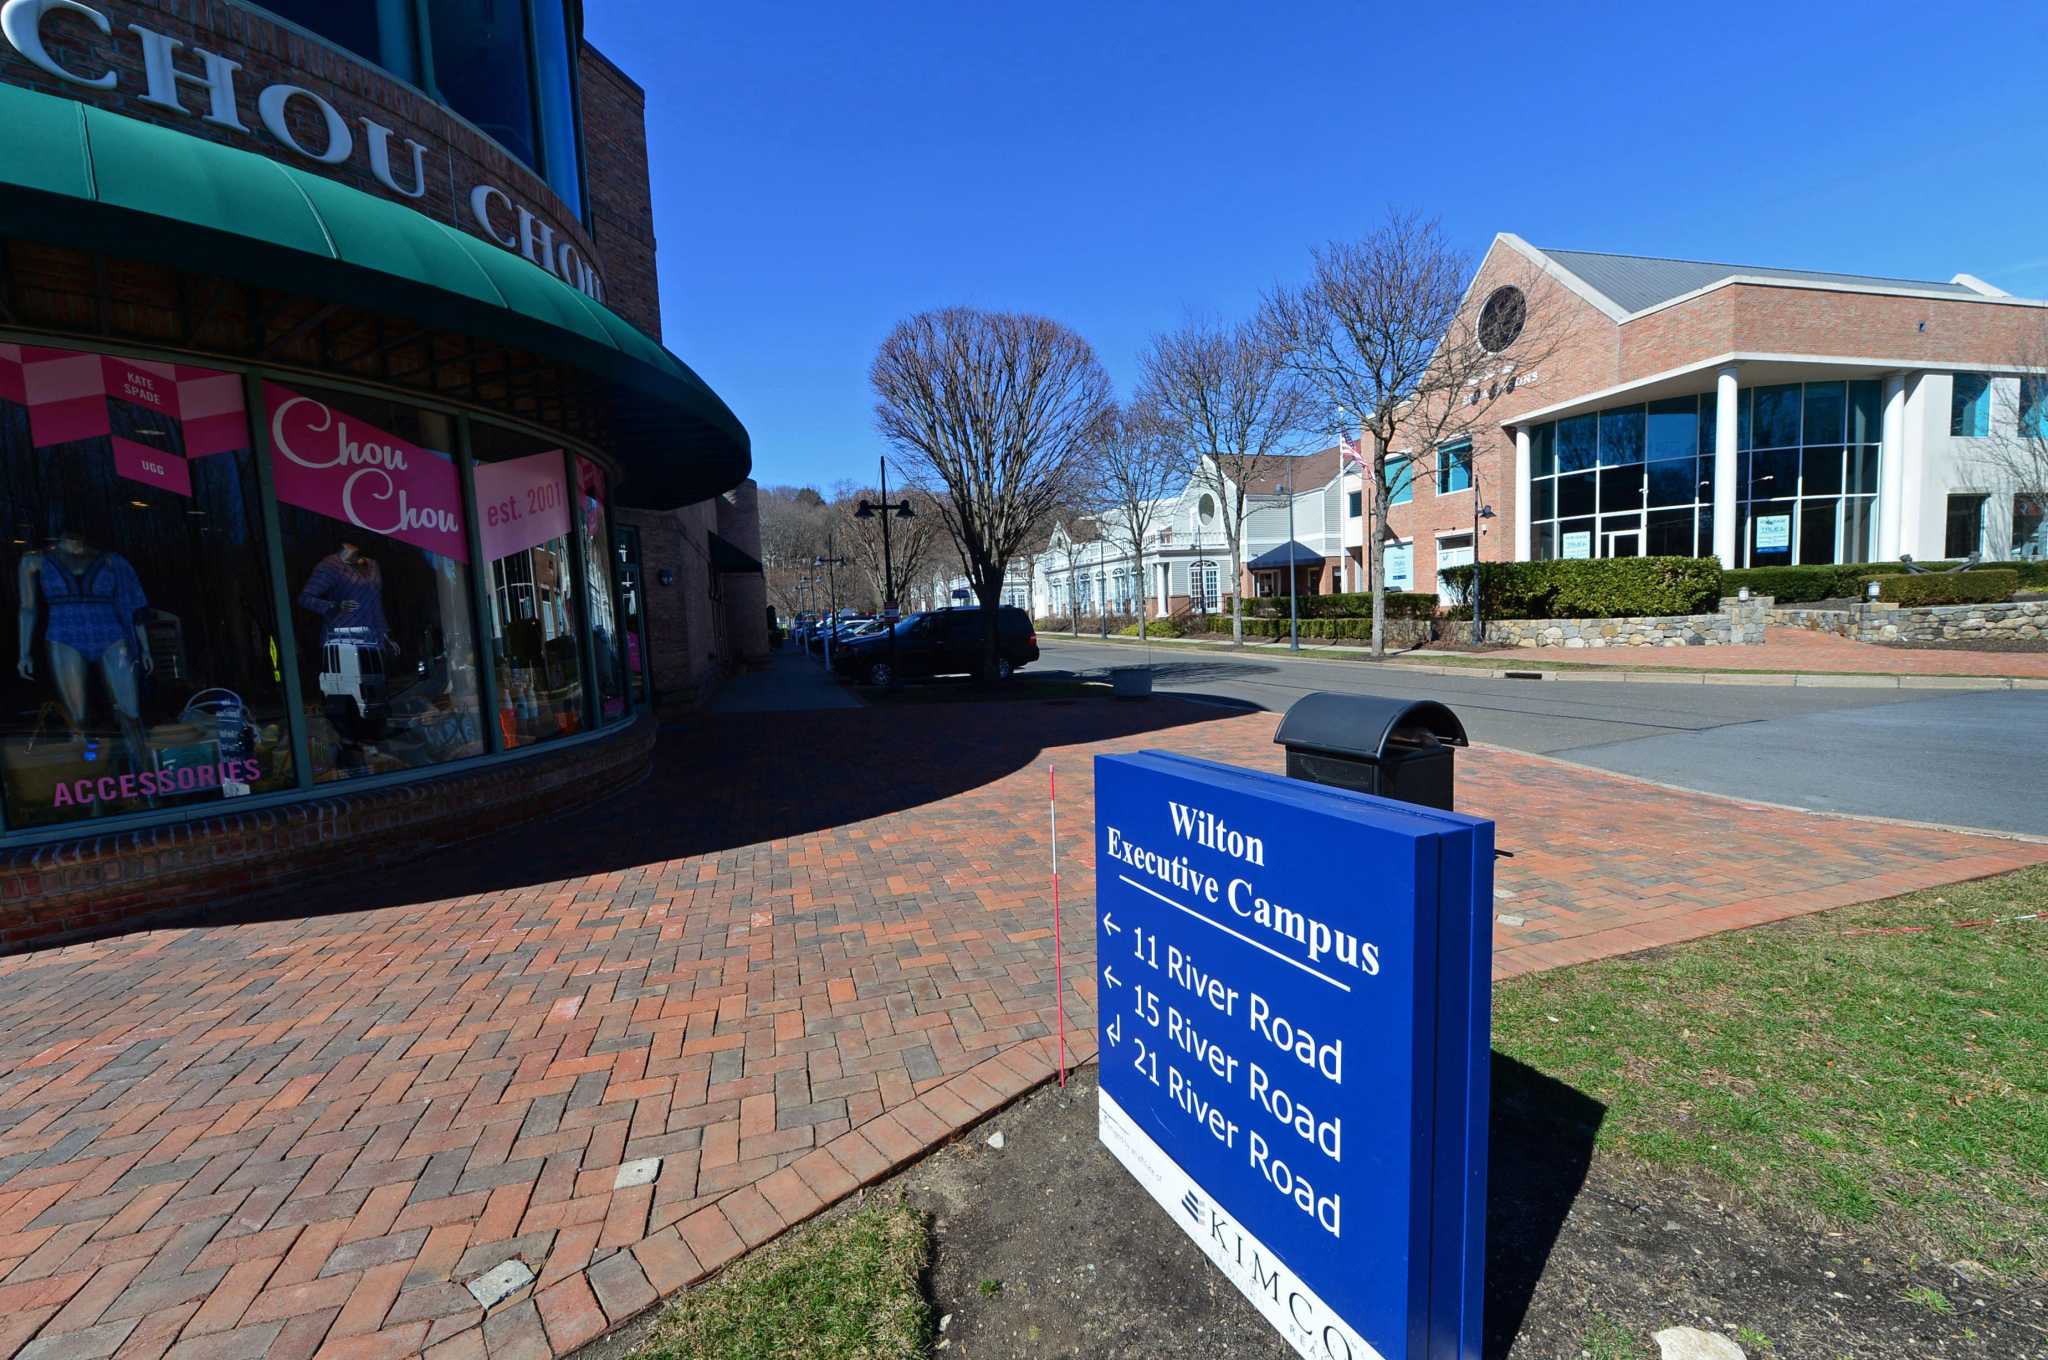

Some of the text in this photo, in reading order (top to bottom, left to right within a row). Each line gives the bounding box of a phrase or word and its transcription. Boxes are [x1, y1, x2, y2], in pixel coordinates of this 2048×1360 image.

[1, 0, 602, 303] CHOU CHOU
[123, 384, 161, 404] SPADE
[127, 372, 154, 390] KATE
[271, 396, 408, 469] Chou
[141, 460, 165, 476] UGG
[342, 467, 459, 535] Chou
[487, 481, 561, 527] est. 2001
[53, 758, 261, 807] ACCESSORIES
[1168, 801, 1265, 867] Wilton
[1107, 826, 1380, 976] Executive Campus
[1134, 927, 1342, 1085] 11 River Road
[1134, 984, 1160, 1027] 15
[1168, 1006, 1239, 1084] River
[1249, 1062, 1341, 1163] Road
[1134, 1037, 1160, 1087] 21
[1168, 1065, 1239, 1149] River
[1250, 1130, 1341, 1239] Road
[1210, 1208, 1353, 1360] KIMCO
